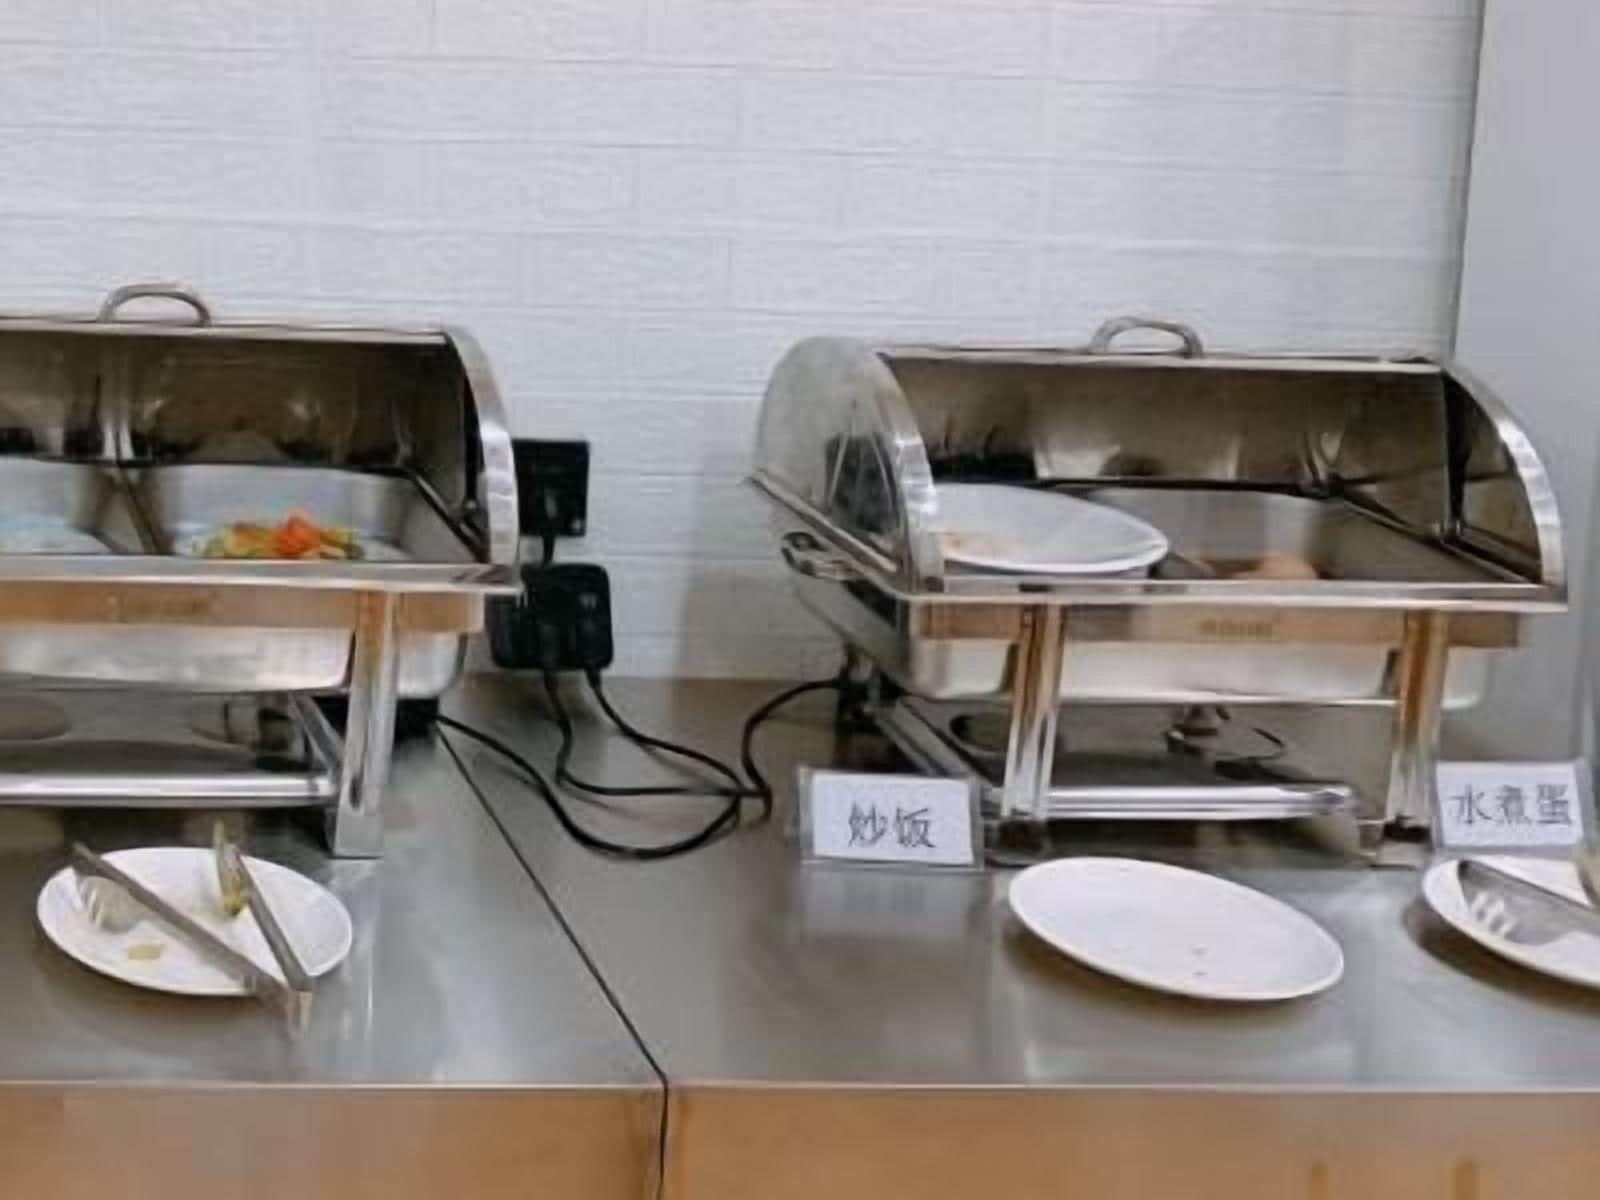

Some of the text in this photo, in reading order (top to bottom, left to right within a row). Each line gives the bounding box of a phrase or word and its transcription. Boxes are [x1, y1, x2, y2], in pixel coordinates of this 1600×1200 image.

[848, 802, 936, 848] 炒饭
[1449, 783, 1572, 825] 水煮蛋
